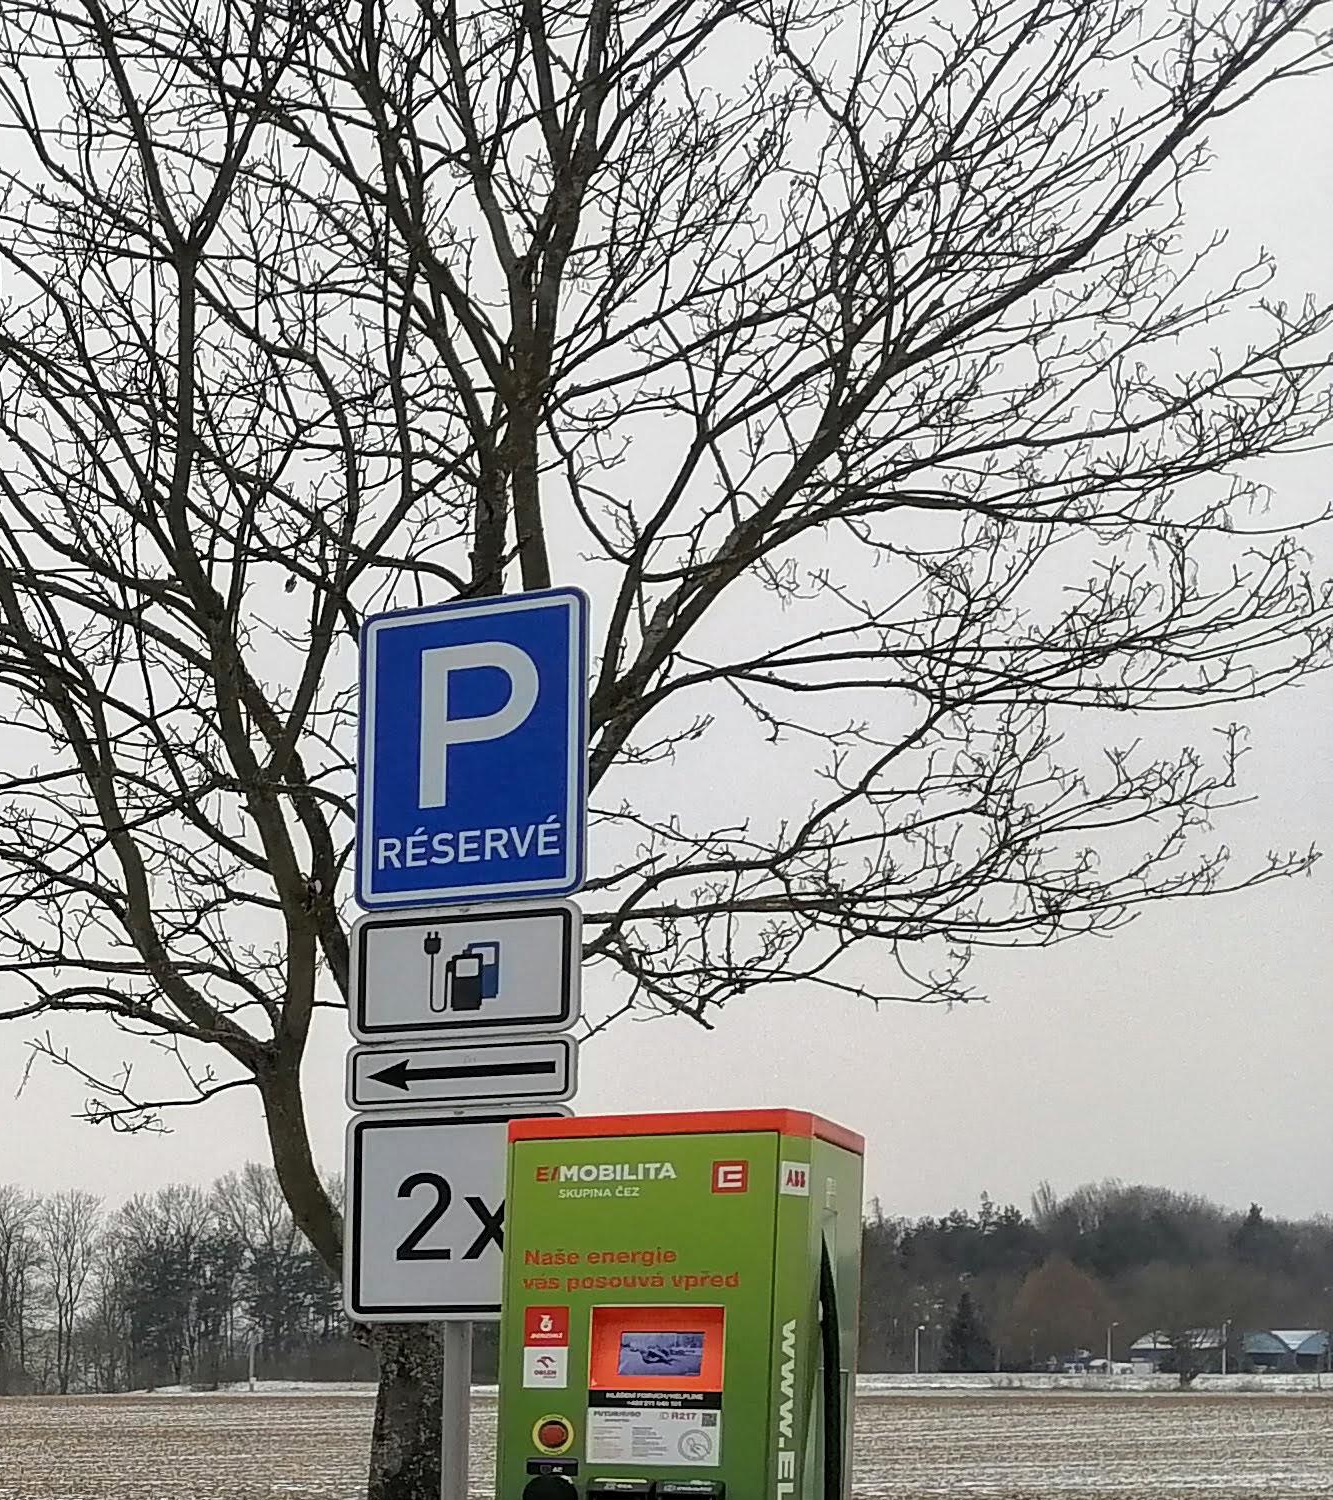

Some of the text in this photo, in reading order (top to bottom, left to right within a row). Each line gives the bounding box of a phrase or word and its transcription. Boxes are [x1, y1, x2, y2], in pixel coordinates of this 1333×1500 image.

[419, 641, 539, 809] P
[378, 815, 561, 870] RÉSERVÉ
[786, 1169, 806, 1188] ABB
[558, 1186, 640, 1198] SKUPINA ČEZ
[396, 1172, 504, 1260] 2x
[524, 1247, 676, 1266] Naše energie
[523, 1271, 740, 1292] vás posouvá vpřed
